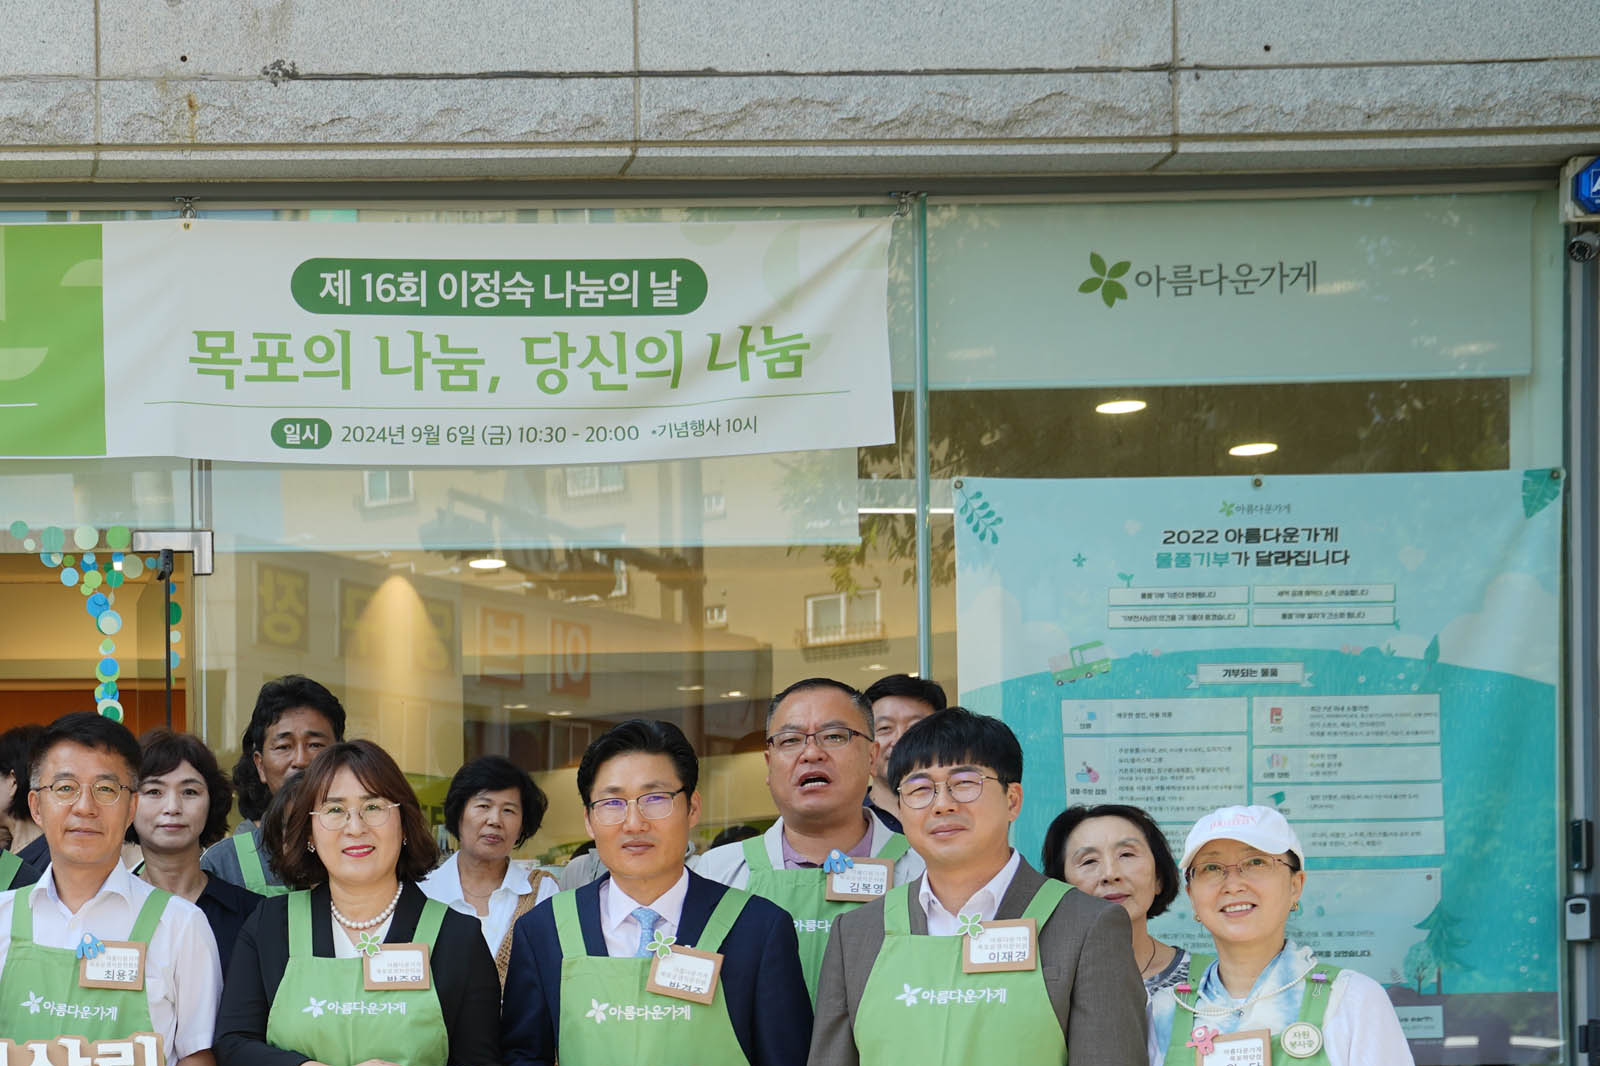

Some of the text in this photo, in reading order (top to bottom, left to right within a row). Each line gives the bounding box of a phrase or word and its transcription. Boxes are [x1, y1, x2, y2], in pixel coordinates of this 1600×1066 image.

[319, 268, 682, 309] 제 16회 이정숙 나눔의 날
[1134, 260, 1317, 299] 아름다운가게
[188, 324, 812, 395] 목포의 나눔, 당신의 나눔
[282, 422, 320, 446] 일시
[341, 424, 406, 446] 2024년
[411, 424, 441, 447] 9월
[446, 424, 475, 446] 6일
[480, 423, 512, 448] (금)
[517, 425, 567, 445] 10:30
[585, 425, 640, 444] 20:00
[725, 417, 759, 437] 10시
[1162, 527, 1339, 545] 2022 아름다운가게
[1155, 549, 1351, 569] 물품기부가 달라집니다
[793, 919, 832, 933] 아름다
[921, 987, 1008, 1006] 아름다운가게
[42, 1000, 119, 1023] 아름다운가게
[326, 1000, 407, 1017] 아름다운가게
[607, 1003, 692, 1022] 아름다운가게
